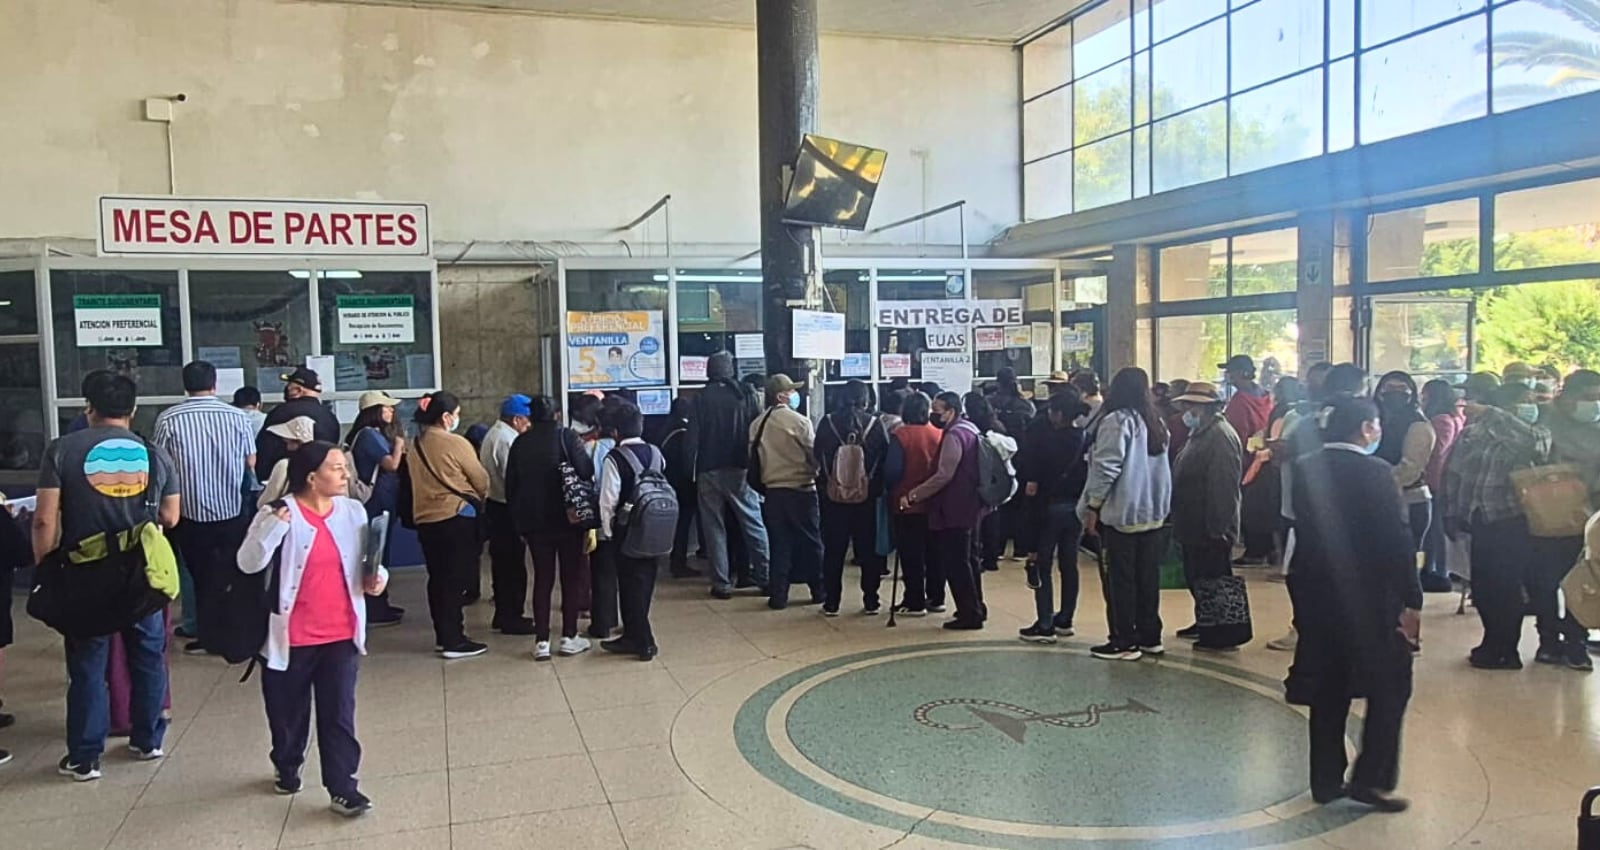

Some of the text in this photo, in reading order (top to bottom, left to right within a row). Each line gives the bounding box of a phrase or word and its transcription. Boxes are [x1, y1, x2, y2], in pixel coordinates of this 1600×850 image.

[113, 209, 417, 246] MESA DE PARTES
[880, 307, 1020, 325] ENTREGA DE
[80, 320, 158, 329] ATENCION PREFERENCIAL
[568, 336, 628, 346] VENTANILLA
[928, 334, 965, 347] FUAS
[579, 348, 595, 373] 5
[966, 355, 971, 363] 2
